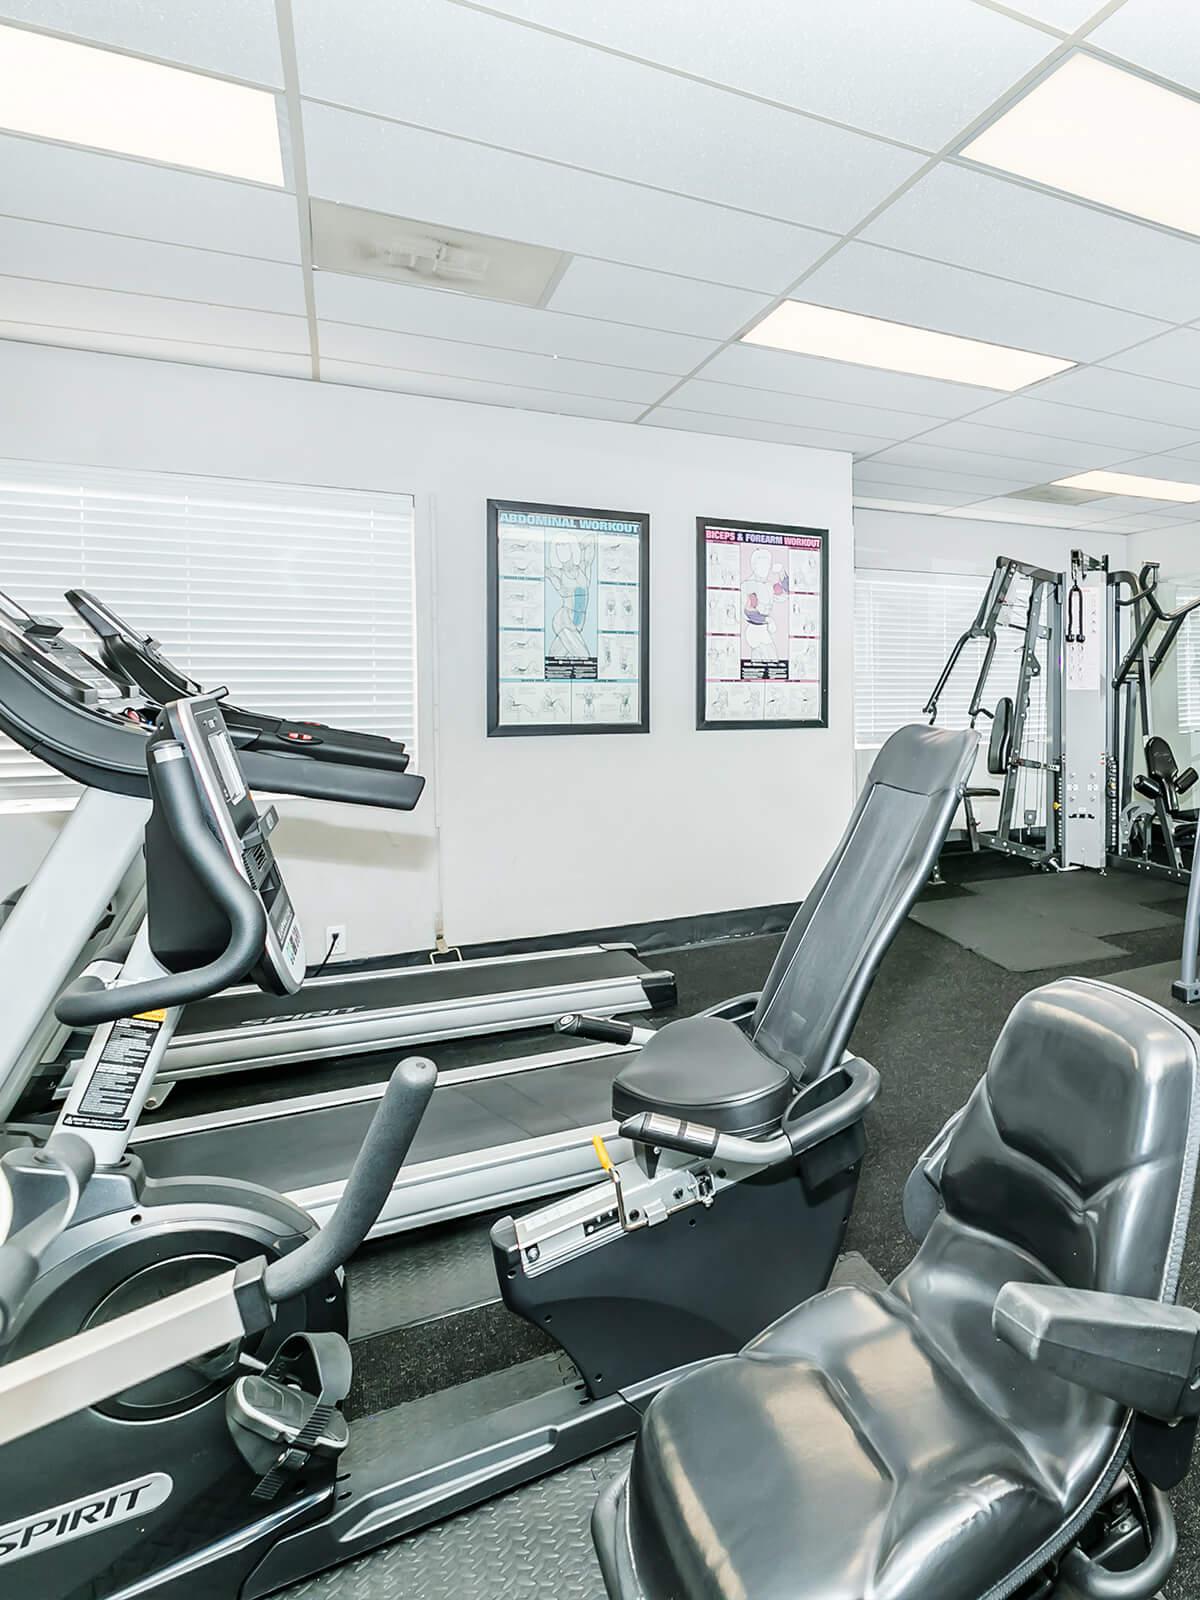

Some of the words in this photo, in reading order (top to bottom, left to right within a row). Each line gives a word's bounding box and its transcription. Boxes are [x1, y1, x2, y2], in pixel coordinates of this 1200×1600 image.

[501, 513, 577, 528] ABDOMINAL
[579, 519, 639, 533] WORKOUT
[706, 530, 736, 541] BICEPS
[737, 533, 744, 541] &
[745, 533, 783, 544] FOREARM
[784, 536, 820, 548] WORKOUT
[240, 1004, 366, 1025] SPIRIT
[0, 1482, 153, 1555] SPIRIT
